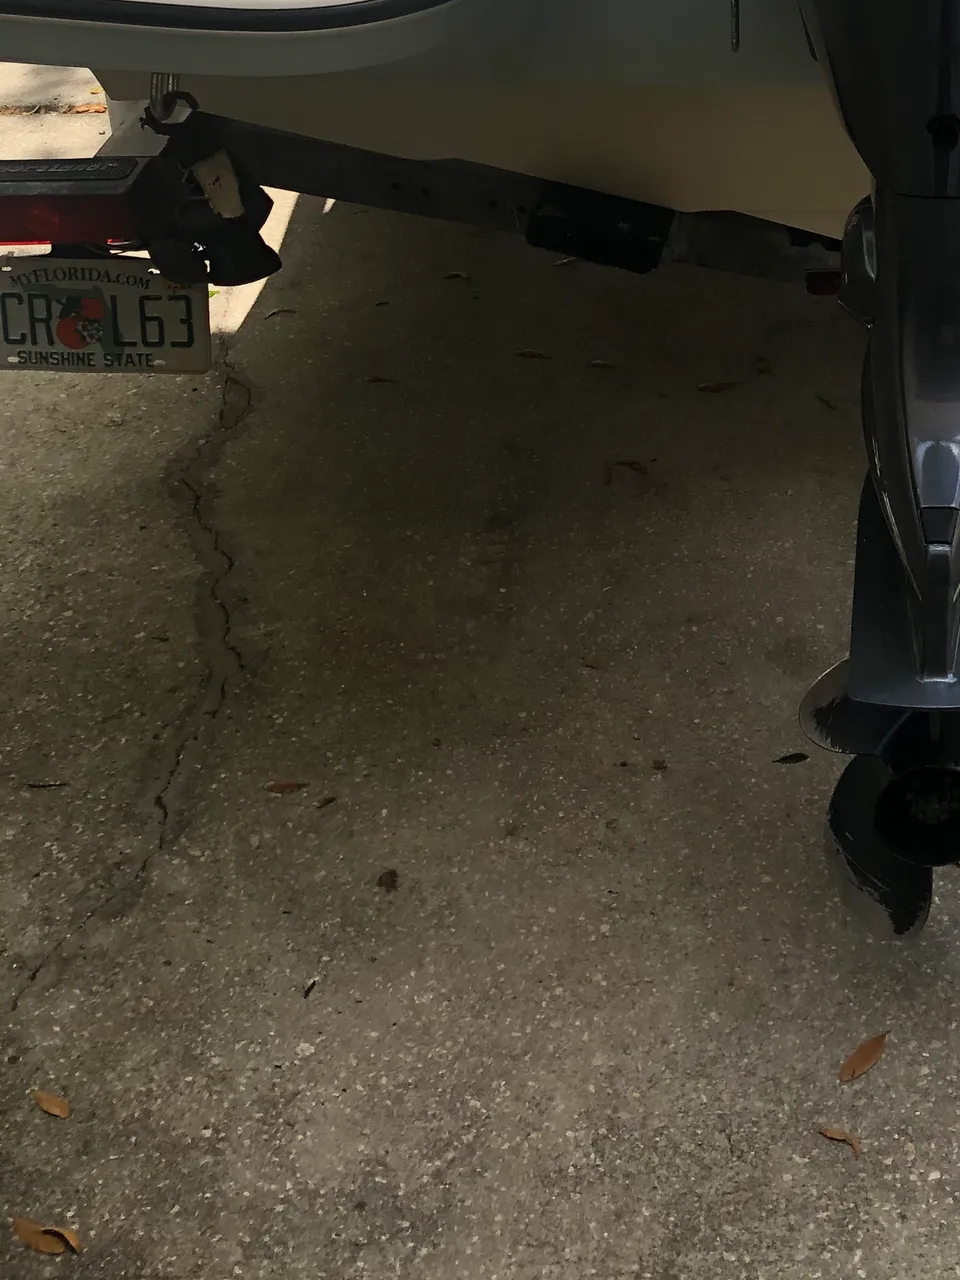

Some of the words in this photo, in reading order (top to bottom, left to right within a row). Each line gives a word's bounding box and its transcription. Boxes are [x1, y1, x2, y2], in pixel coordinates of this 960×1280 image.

[8, 267, 150, 290] MYFLORIDA.COM
[110, 294, 195, 348] L63
[17, 350, 96, 367] SUNSHINE
[104, 352, 155, 369] STATE
